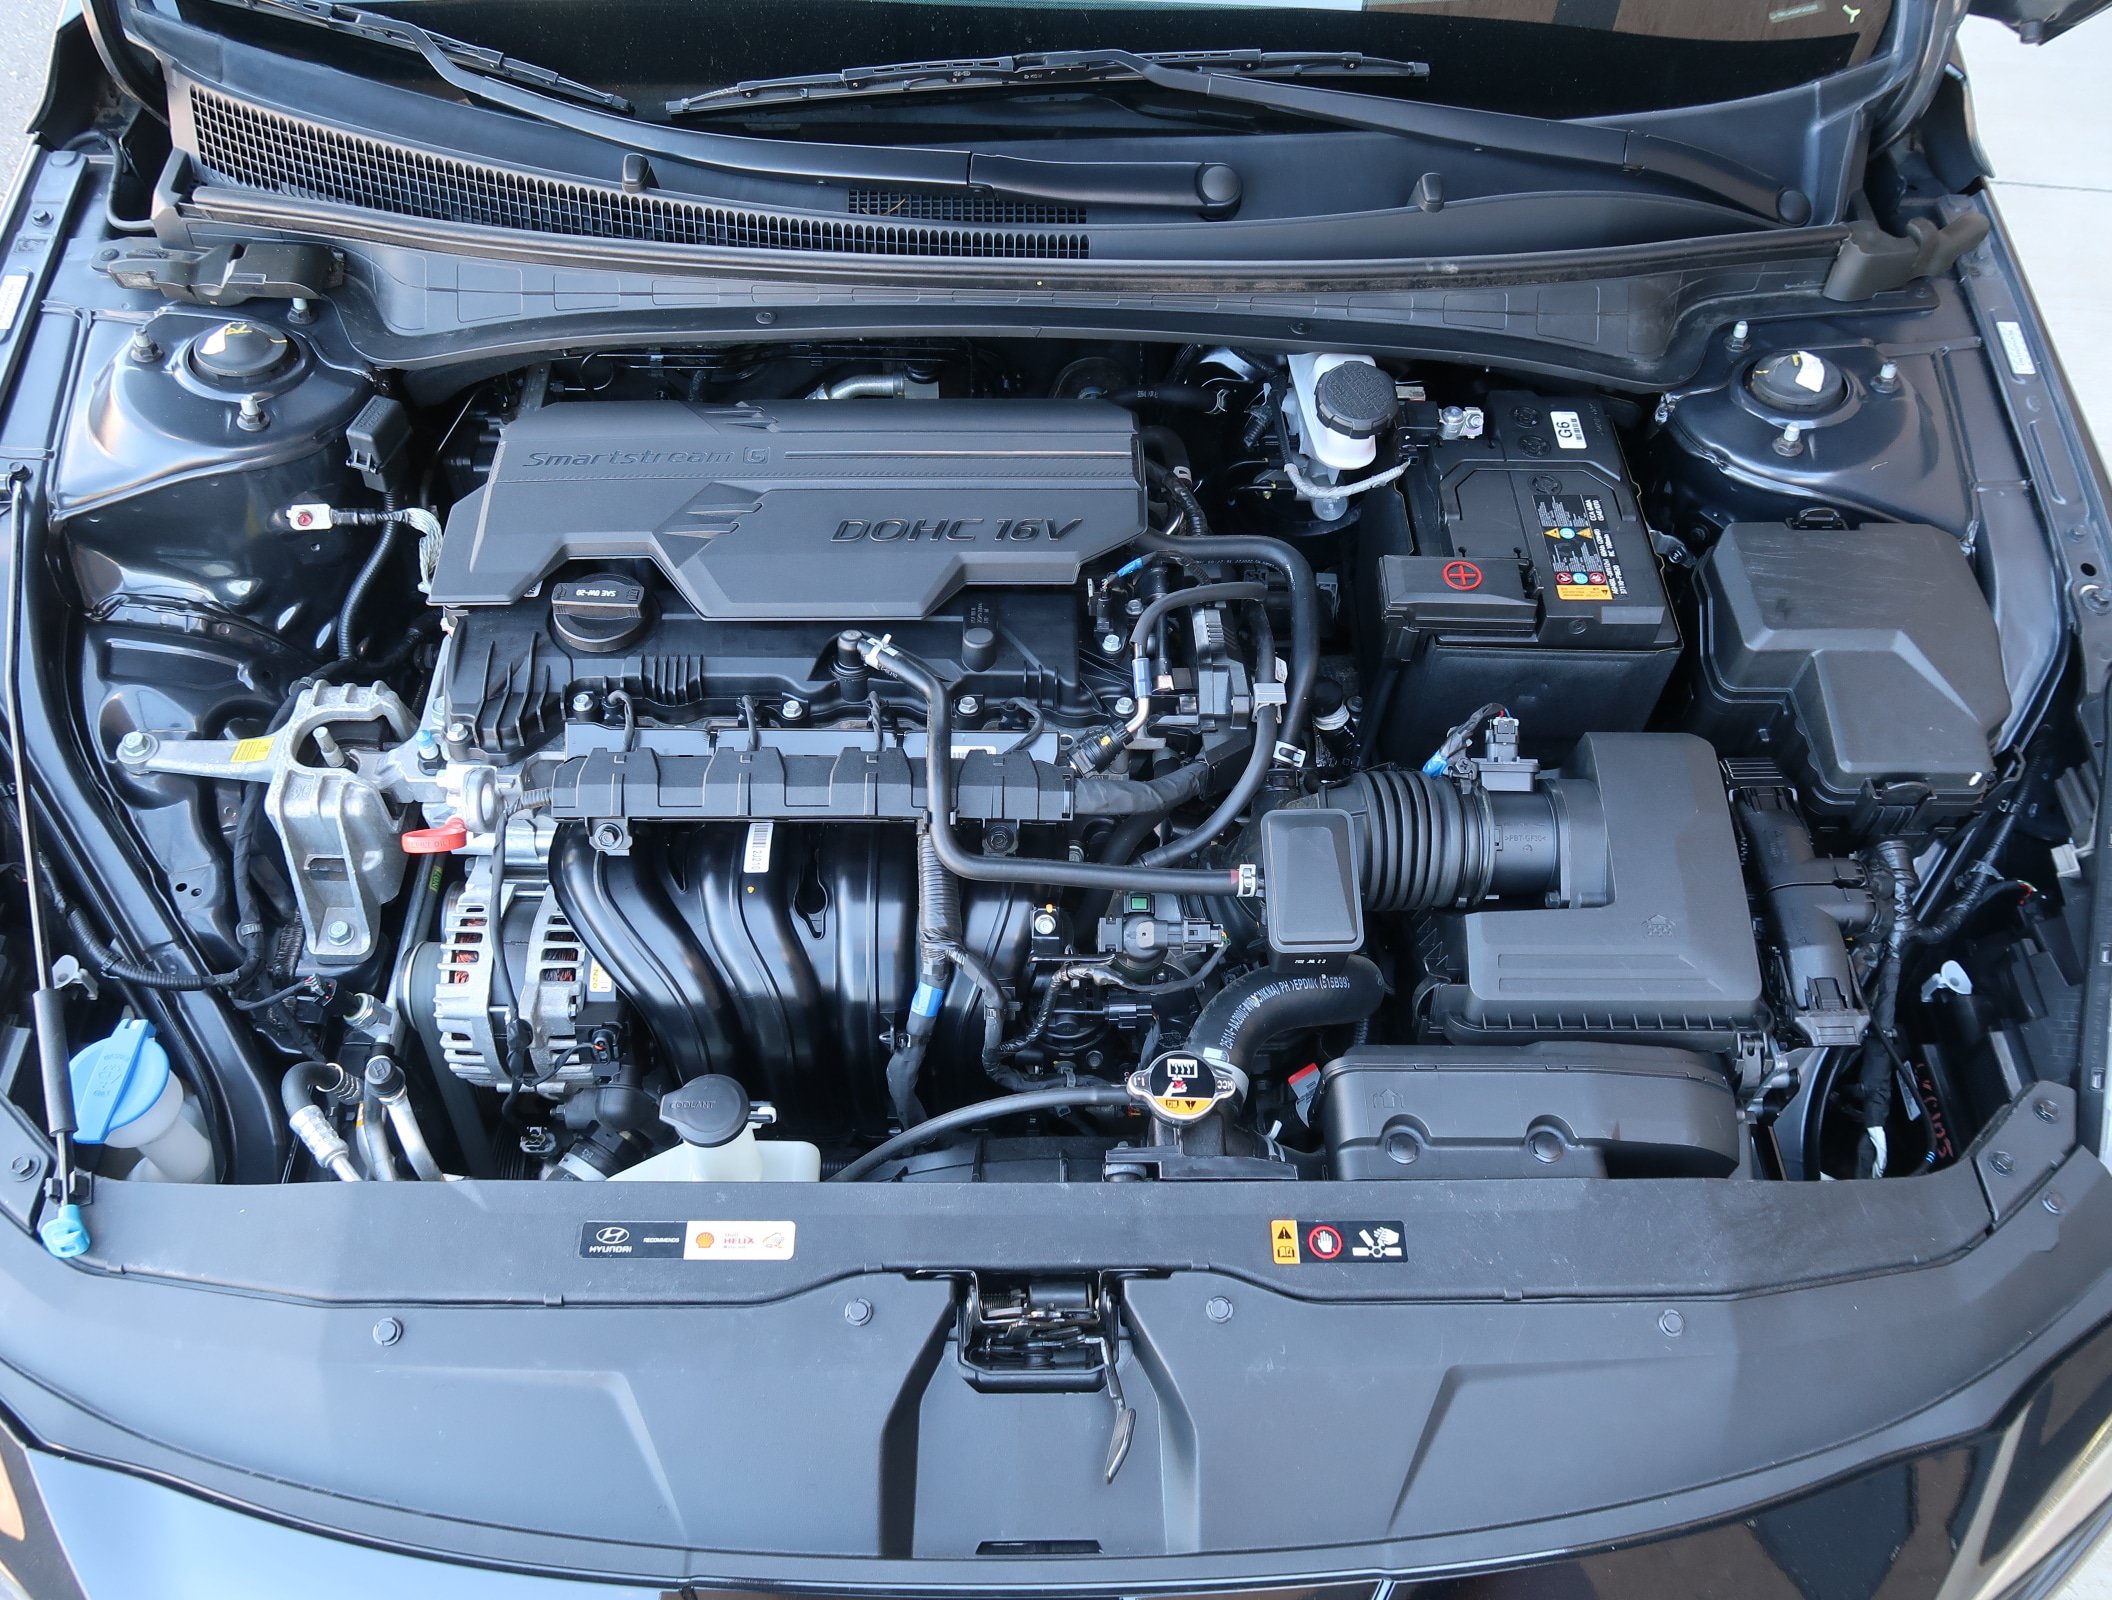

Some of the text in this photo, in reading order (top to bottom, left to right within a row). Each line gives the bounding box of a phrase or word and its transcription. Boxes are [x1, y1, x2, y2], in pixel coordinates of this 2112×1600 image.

[1556, 421, 1573, 439] G6
[522, 448, 736, 468] Smartstream
[830, 518, 1083, 542] DOHC 16V
[575, 589, 617, 598] SAE 0W-20
[1278, 980, 1291, 993] PH
[373, 1062, 387, 1077] H
[1216, 1080, 1233, 1090] HCC
[670, 1100, 716, 1109] COOLANT
[589, 1245, 633, 1254] HYUNDAI
[723, 1236, 755, 1244] HELIX
